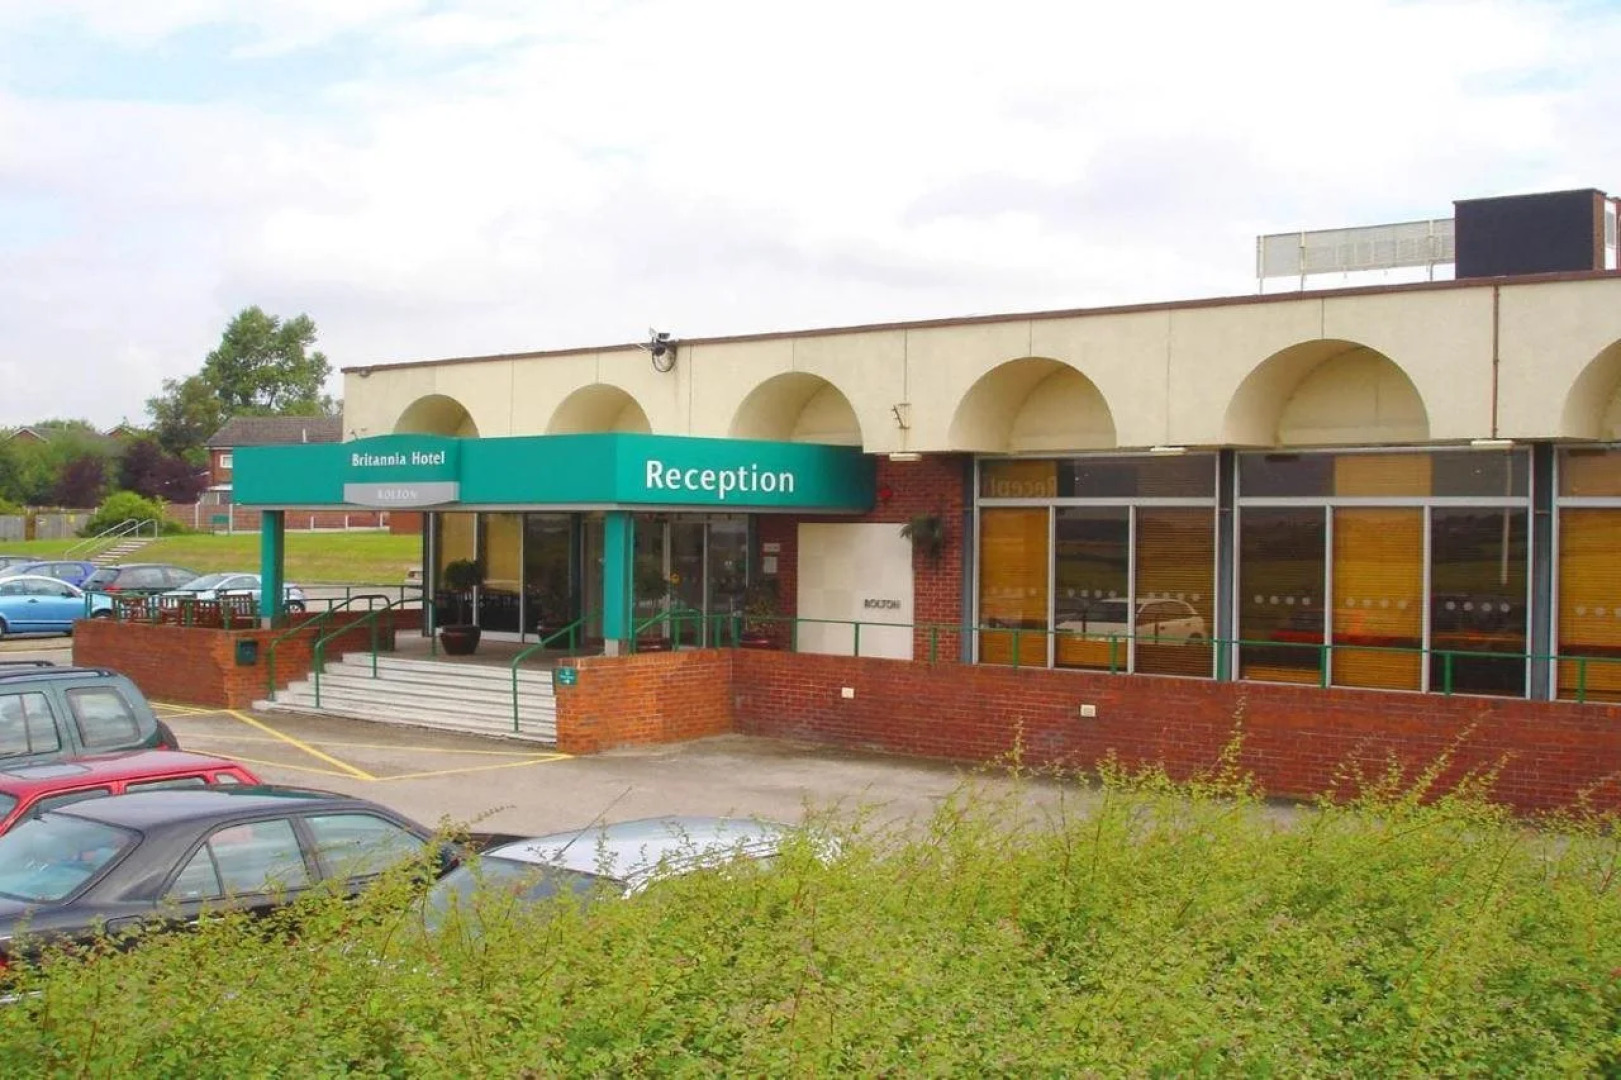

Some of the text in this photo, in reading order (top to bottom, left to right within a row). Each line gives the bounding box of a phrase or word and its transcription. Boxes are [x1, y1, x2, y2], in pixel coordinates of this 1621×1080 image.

[352, 451, 445, 467] Britannia Hotel
[646, 460, 794, 500] Reception
